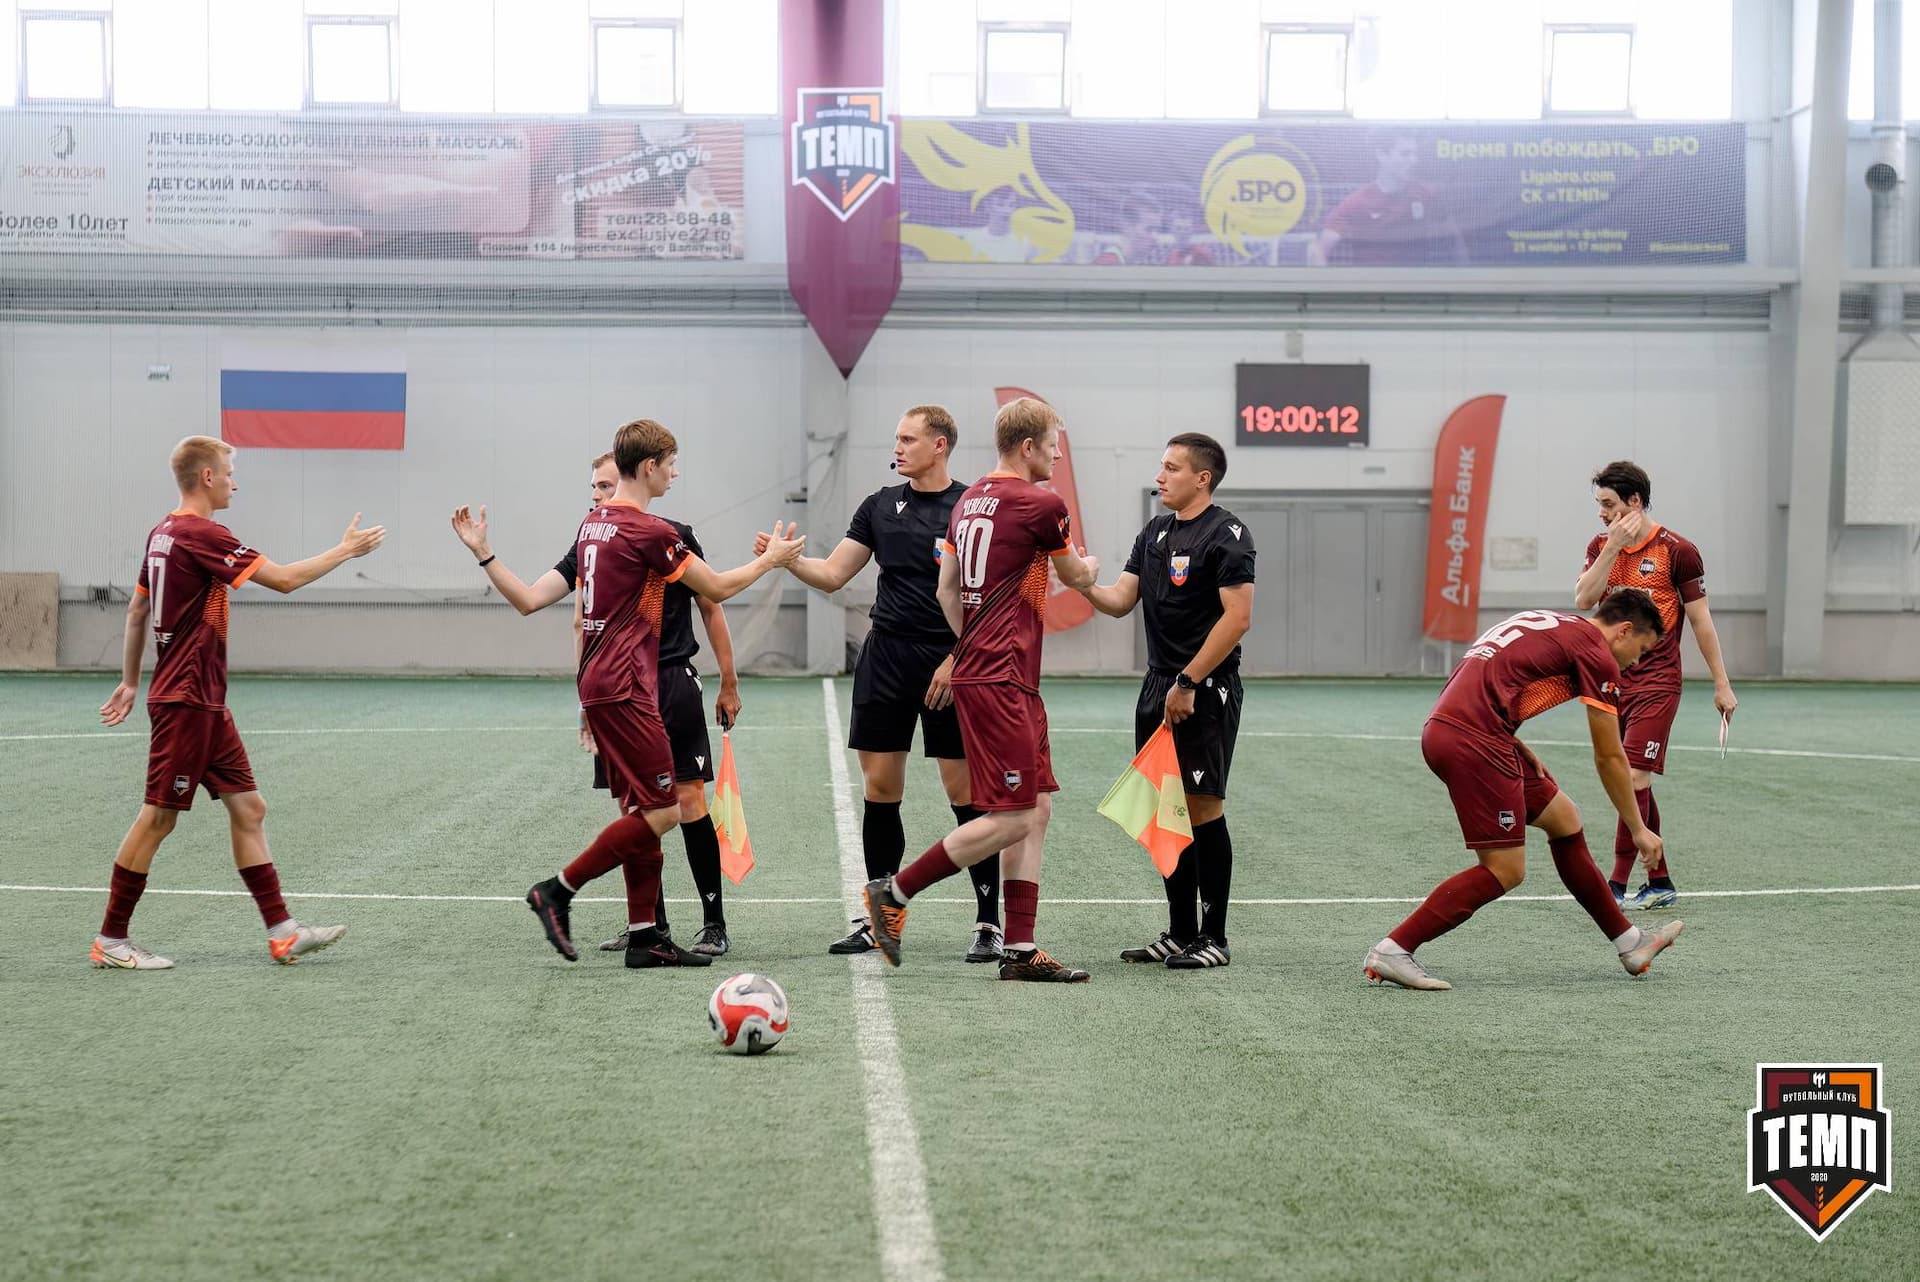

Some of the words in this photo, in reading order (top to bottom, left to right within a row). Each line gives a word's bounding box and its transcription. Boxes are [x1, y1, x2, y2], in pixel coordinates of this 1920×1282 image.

[656, 144, 712, 176] 20%
[802, 125, 885, 170] ТЕМП
[1436, 139, 1507, 161] Время
[1512, 138, 1640, 159] побеждать,
[147, 176, 235, 191] ДЕТСКИЙ
[1520, 188, 1543, 203] СК
[1241, 405, 1359, 433] 19:00:12
[1450, 446, 1476, 513] Банк
[1440, 515, 1470, 604] Альфа
[583, 544, 598, 614] 3
[1645, 741, 1660, 758] 23
